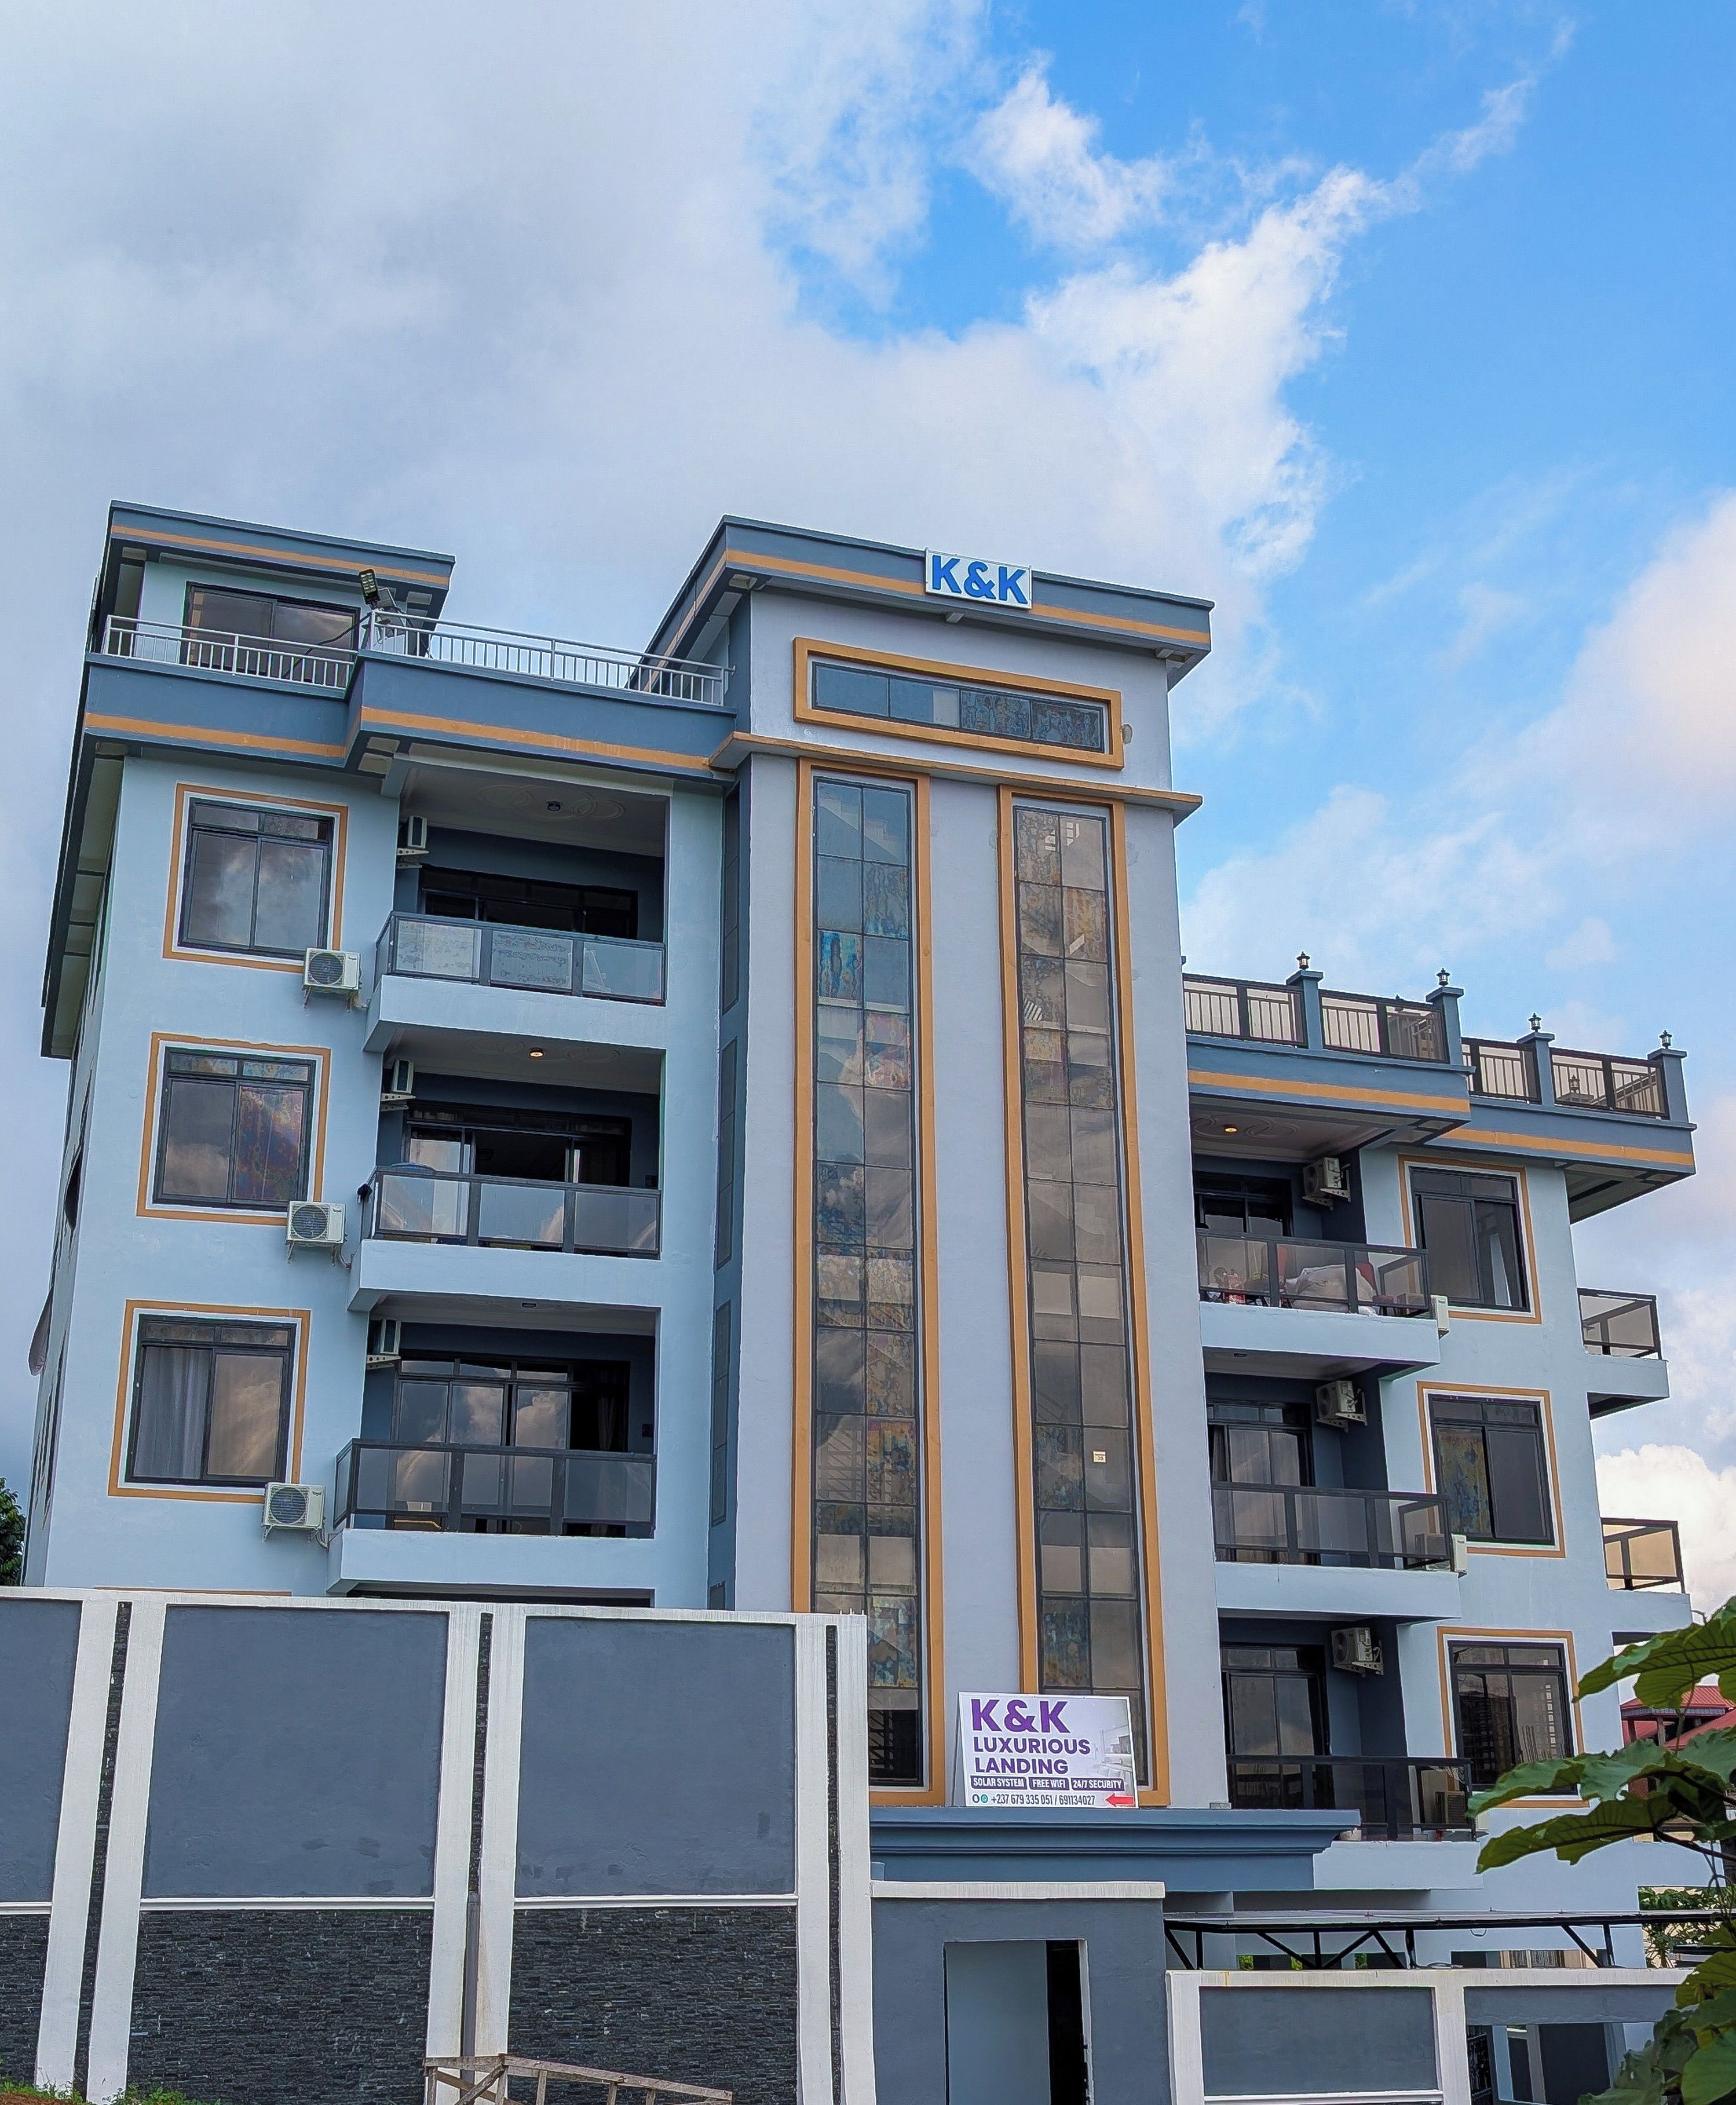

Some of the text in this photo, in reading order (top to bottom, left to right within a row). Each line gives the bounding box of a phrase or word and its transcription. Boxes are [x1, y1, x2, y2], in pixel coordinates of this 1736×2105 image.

[932, 554, 1028, 604] K&K
[971, 1698, 1070, 1733] K&K
[973, 1737, 1091, 1755] LUXURIOUS
[975, 1757, 1068, 1774] LANDING
[973, 1777, 1024, 1787] SOLAR SYSTEM
[1032, 1779, 1066, 1788] FREE WIFI
[1073, 1779, 1121, 1789] 24/7 SECURITY
[991, 1794, 1009, 1804] +237
[1011, 1794, 1024, 1804] 679
[1026, 1795, 1039, 1804] 335
[1041, 1795, 1052, 1804] 051
[1059, 1795, 1095, 1805] 691134027
